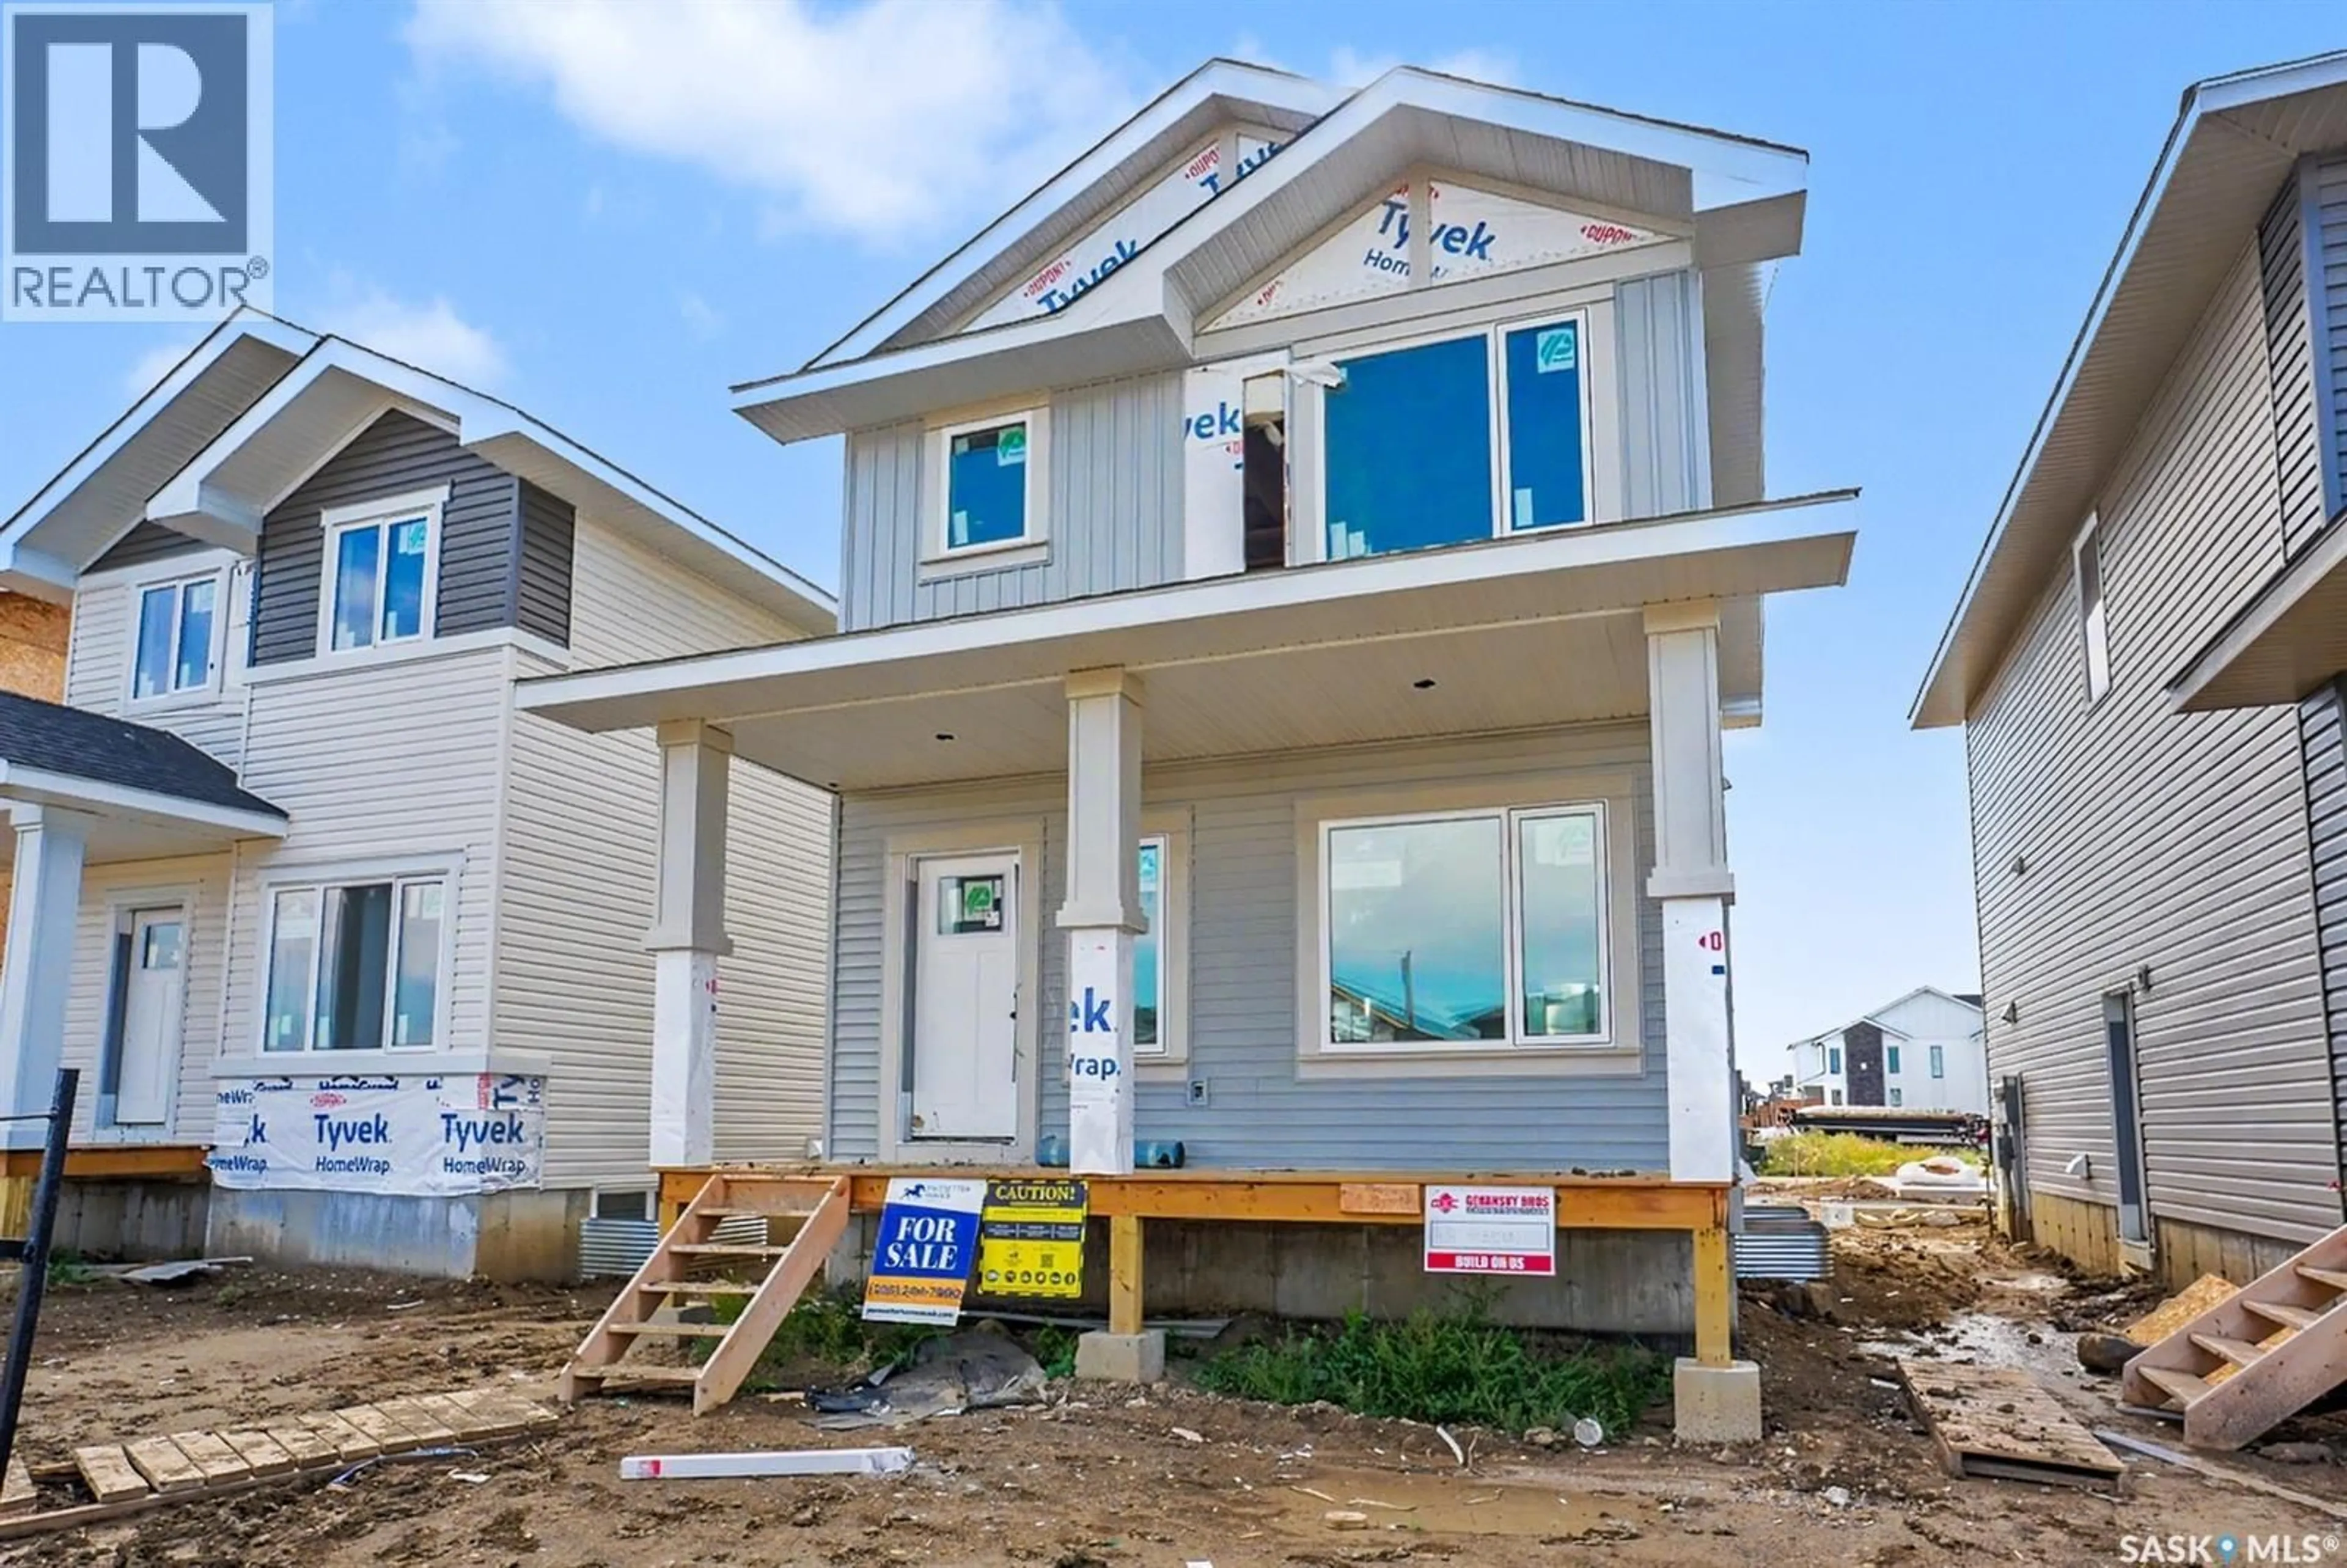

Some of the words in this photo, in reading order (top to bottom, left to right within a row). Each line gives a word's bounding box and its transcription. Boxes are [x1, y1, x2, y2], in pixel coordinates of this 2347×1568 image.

[314, 1113, 389, 1152] Tyvek
[441, 1112, 524, 1153] Tyvek
[315, 1156, 391, 1176] HomeWrap
[995, 1185, 1076, 1201] CAUTION!
[896, 1215, 957, 1243] FOR
[884, 1242, 958, 1270] SALE
[1455, 1255, 1489, 1269] BUILD
